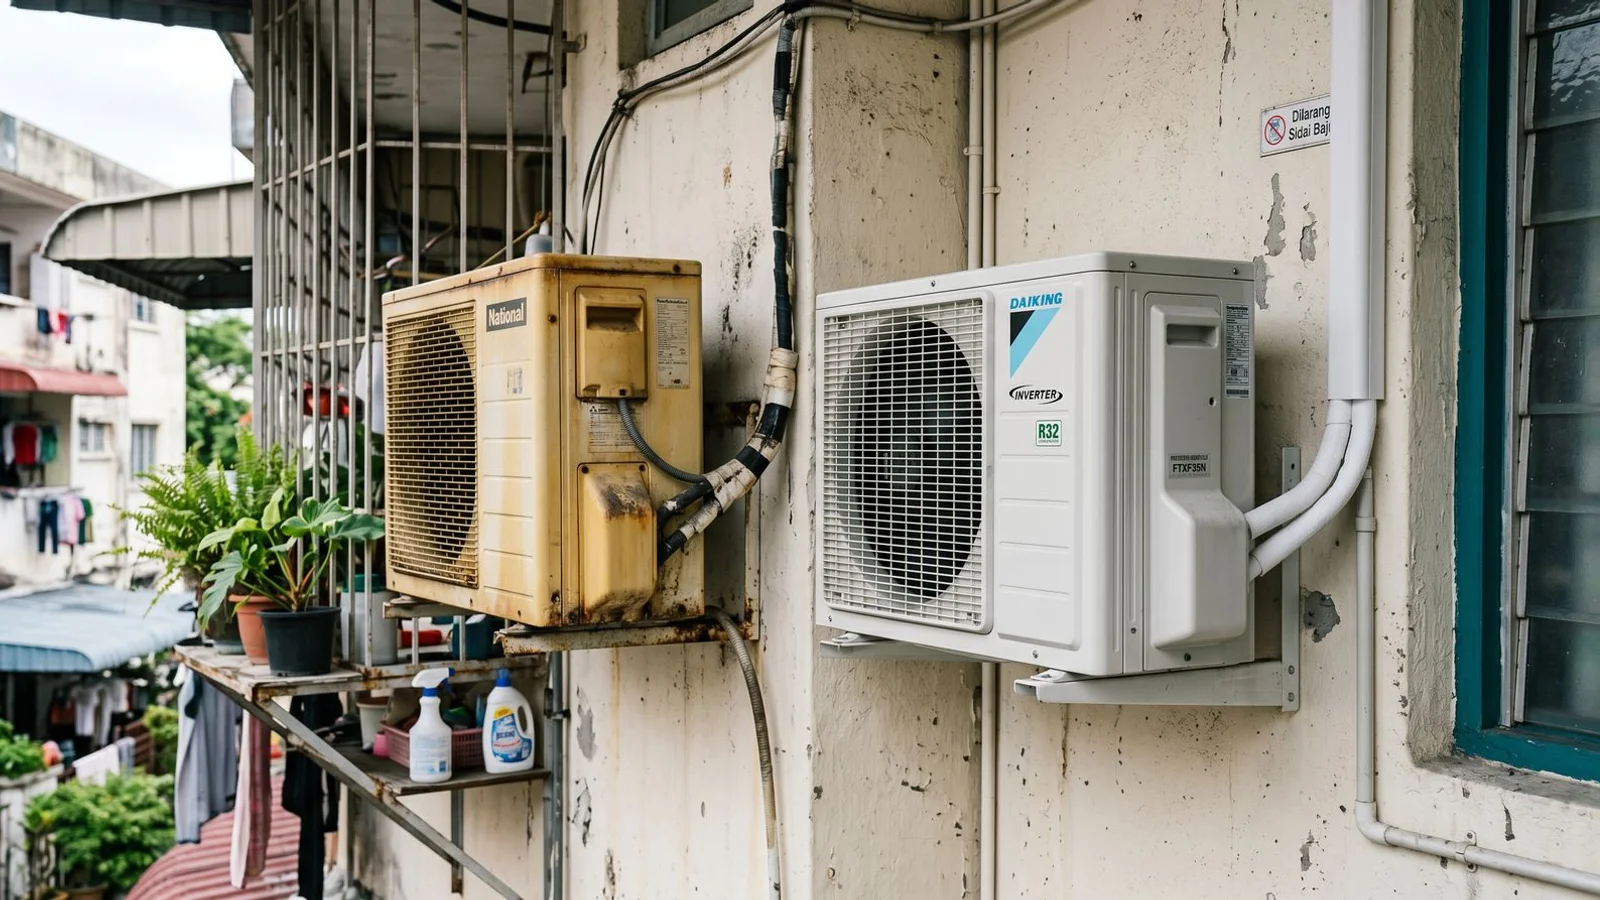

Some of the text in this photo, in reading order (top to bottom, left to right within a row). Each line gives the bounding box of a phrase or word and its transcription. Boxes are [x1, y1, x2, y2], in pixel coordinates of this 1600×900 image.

[1292, 105, 1330, 123] Dilarang
[1288, 124, 1311, 141] Sidai
[1010, 292, 1063, 309] DAIKING
[488, 302, 524, 327] National
[1014, 389, 1057, 400] INVERTER
[1038, 423, 1059, 439] R32
[1172, 463, 1206, 473] FTXF35N
